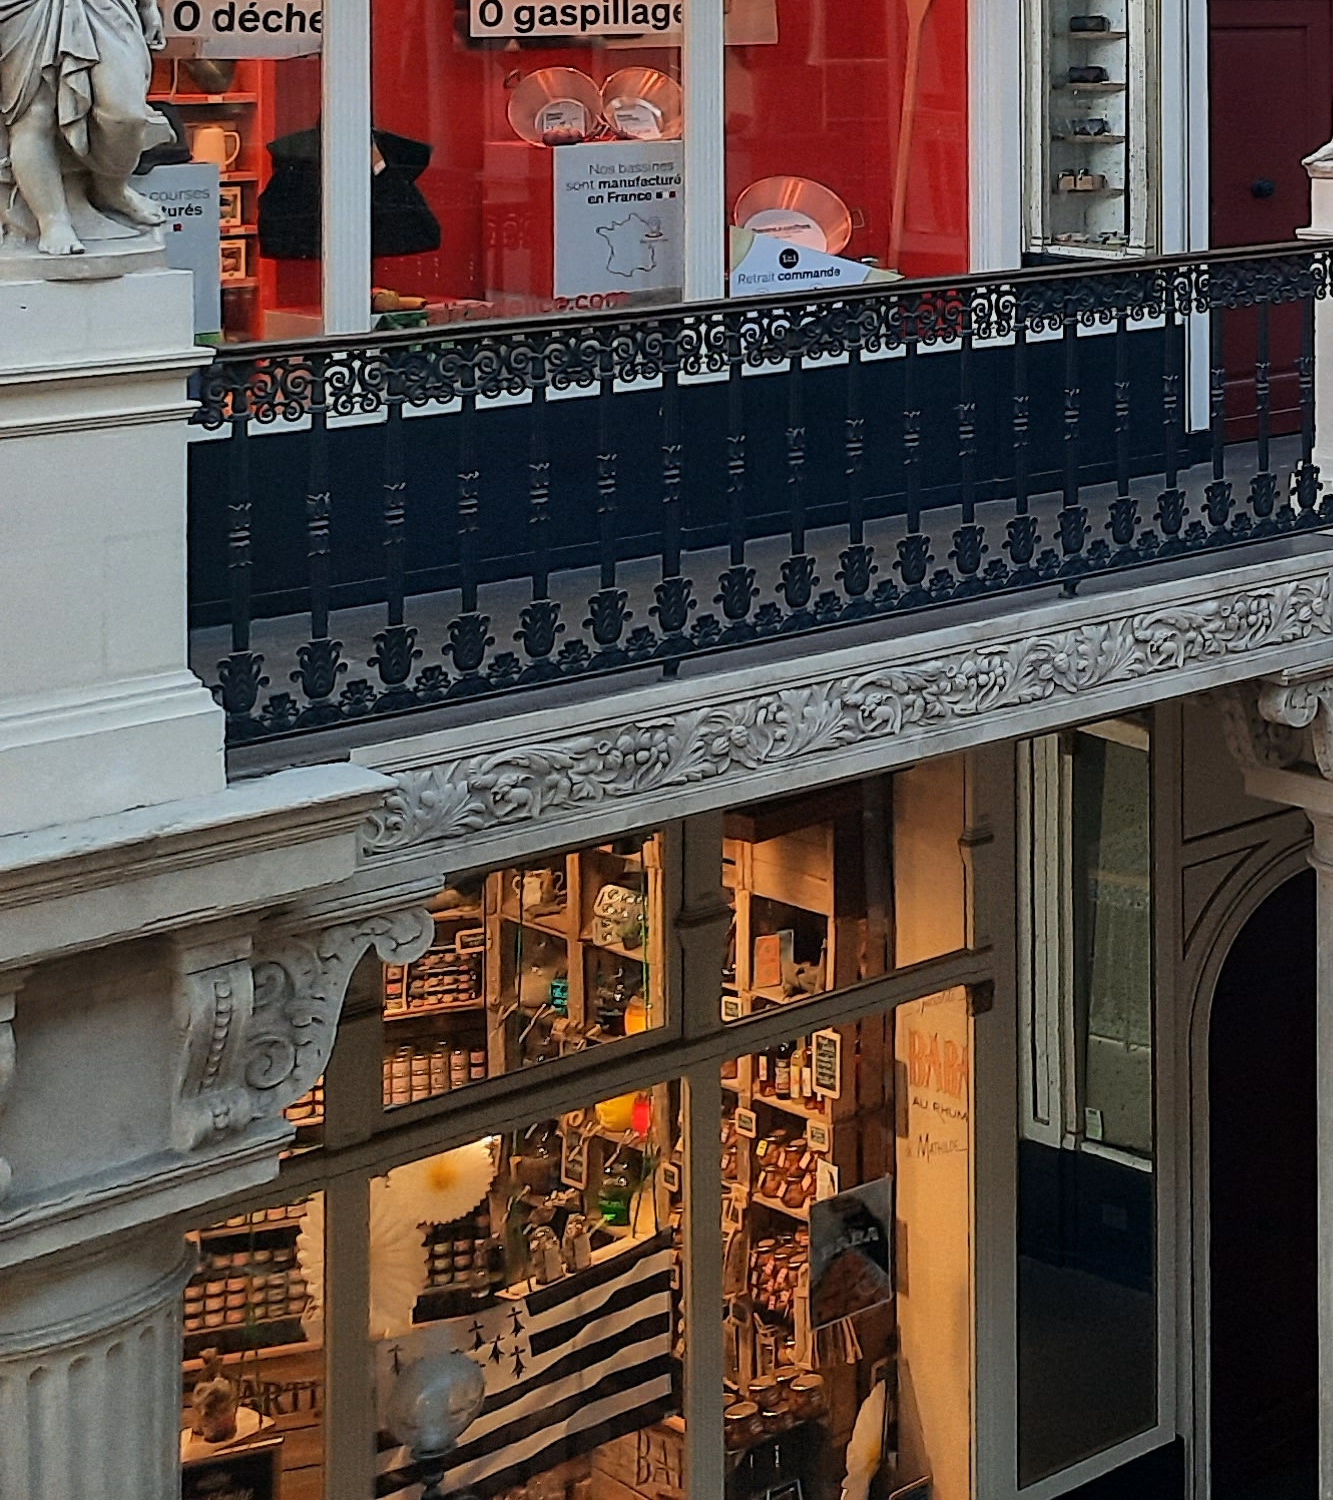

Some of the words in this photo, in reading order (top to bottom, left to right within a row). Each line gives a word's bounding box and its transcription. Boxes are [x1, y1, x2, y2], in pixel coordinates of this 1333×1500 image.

[212, 1, 322, 33] déche
[589, 163, 615, 175] Nos
[618, 161, 674, 174] bassines
[566, 180, 595, 191] sont
[598, 173, 682, 190] manufacturé
[149, 188, 210, 202] courses
[588, 194, 604, 204] en
[607, 191, 652, 203] France
[738, 272, 775, 285] Retrait
[777, 266, 841, 282] commande
[912, 1096, 928, 1109] AU
